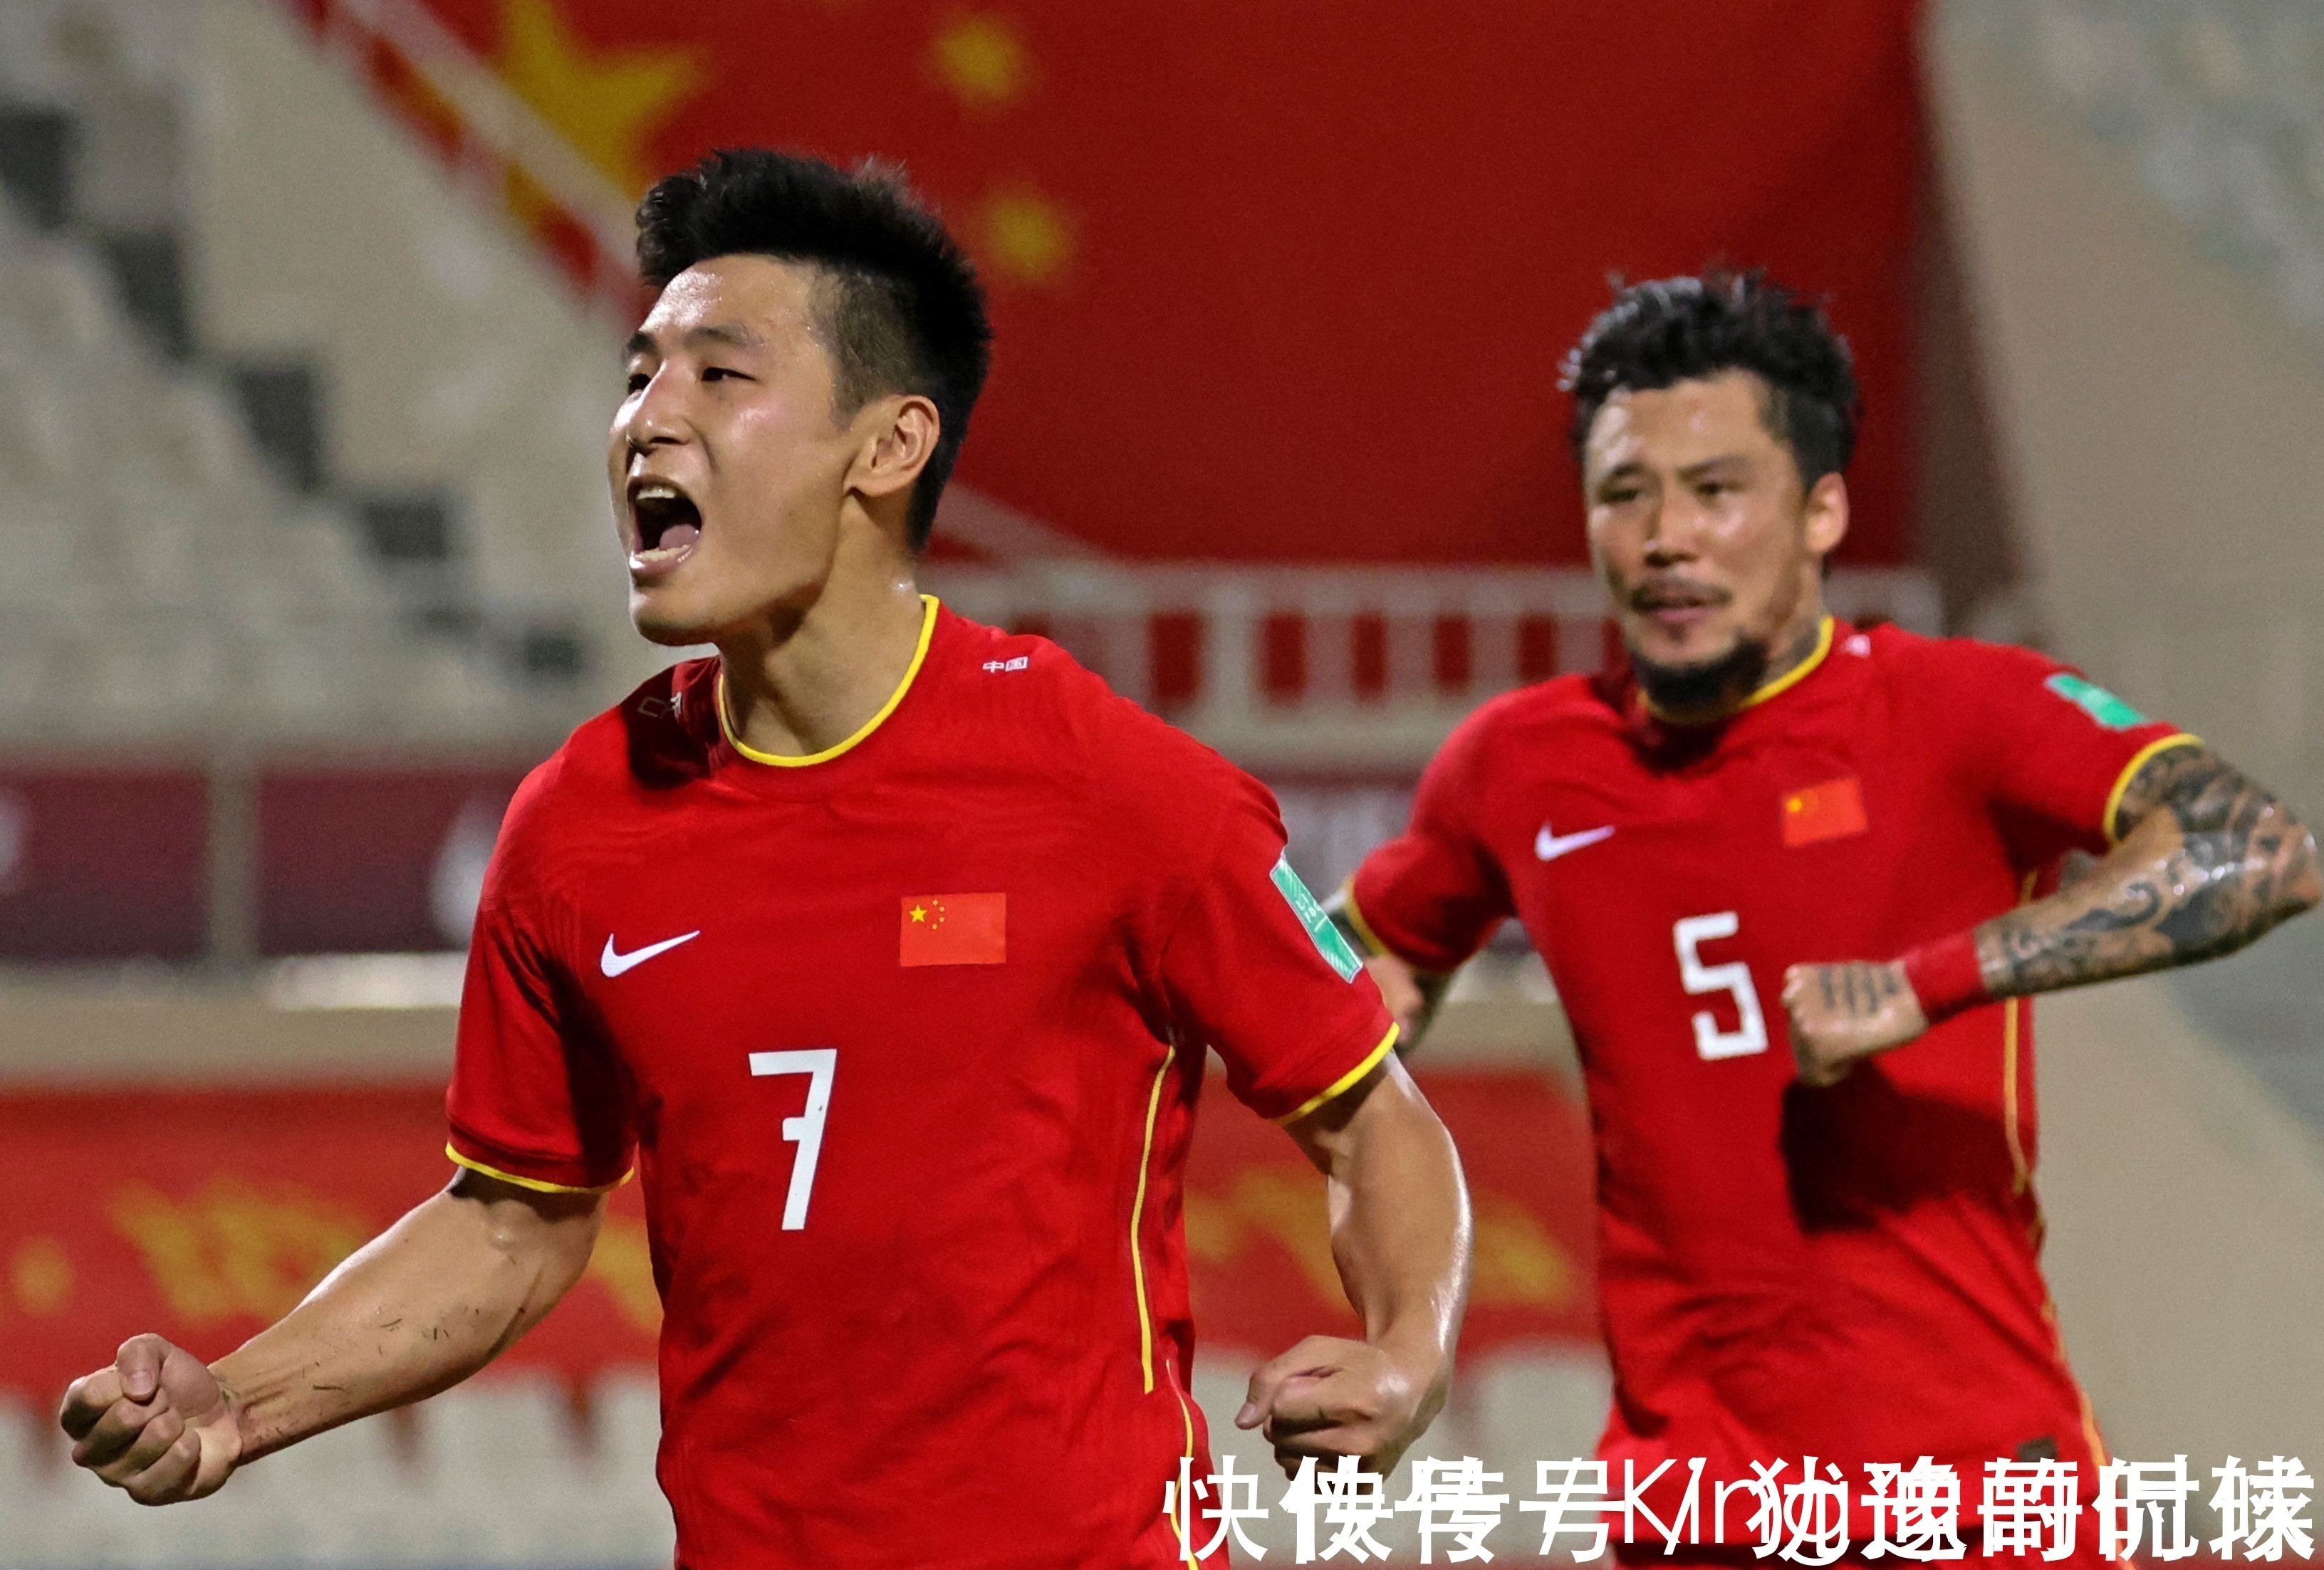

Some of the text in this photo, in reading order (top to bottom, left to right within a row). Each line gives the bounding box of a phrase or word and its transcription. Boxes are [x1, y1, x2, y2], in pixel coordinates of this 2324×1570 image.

[983, 656, 1028, 674] 中国
[1673, 910, 1768, 1061] 5
[749, 1048, 838, 1230] 7
